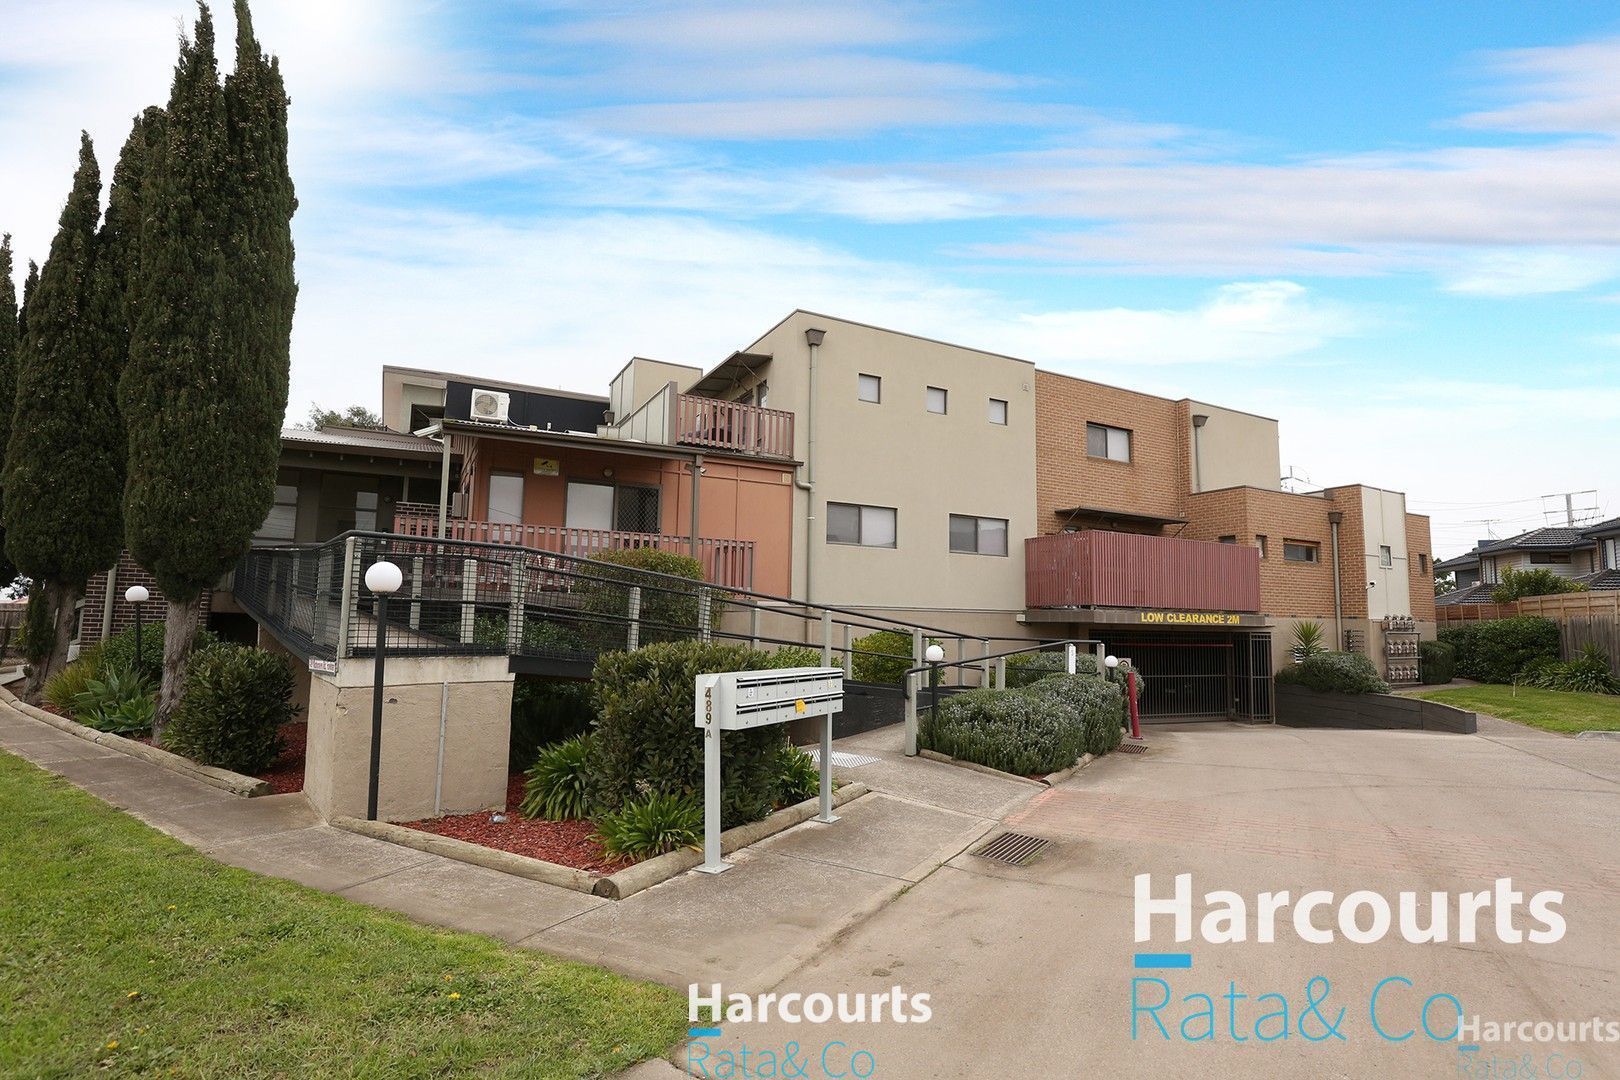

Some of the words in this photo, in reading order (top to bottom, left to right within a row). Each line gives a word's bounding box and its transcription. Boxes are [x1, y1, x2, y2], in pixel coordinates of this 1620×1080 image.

[1141, 612, 1164, 623] LOW
[1166, 613, 1225, 624] CLEARANCE
[1227, 614, 1240, 625] 2M
